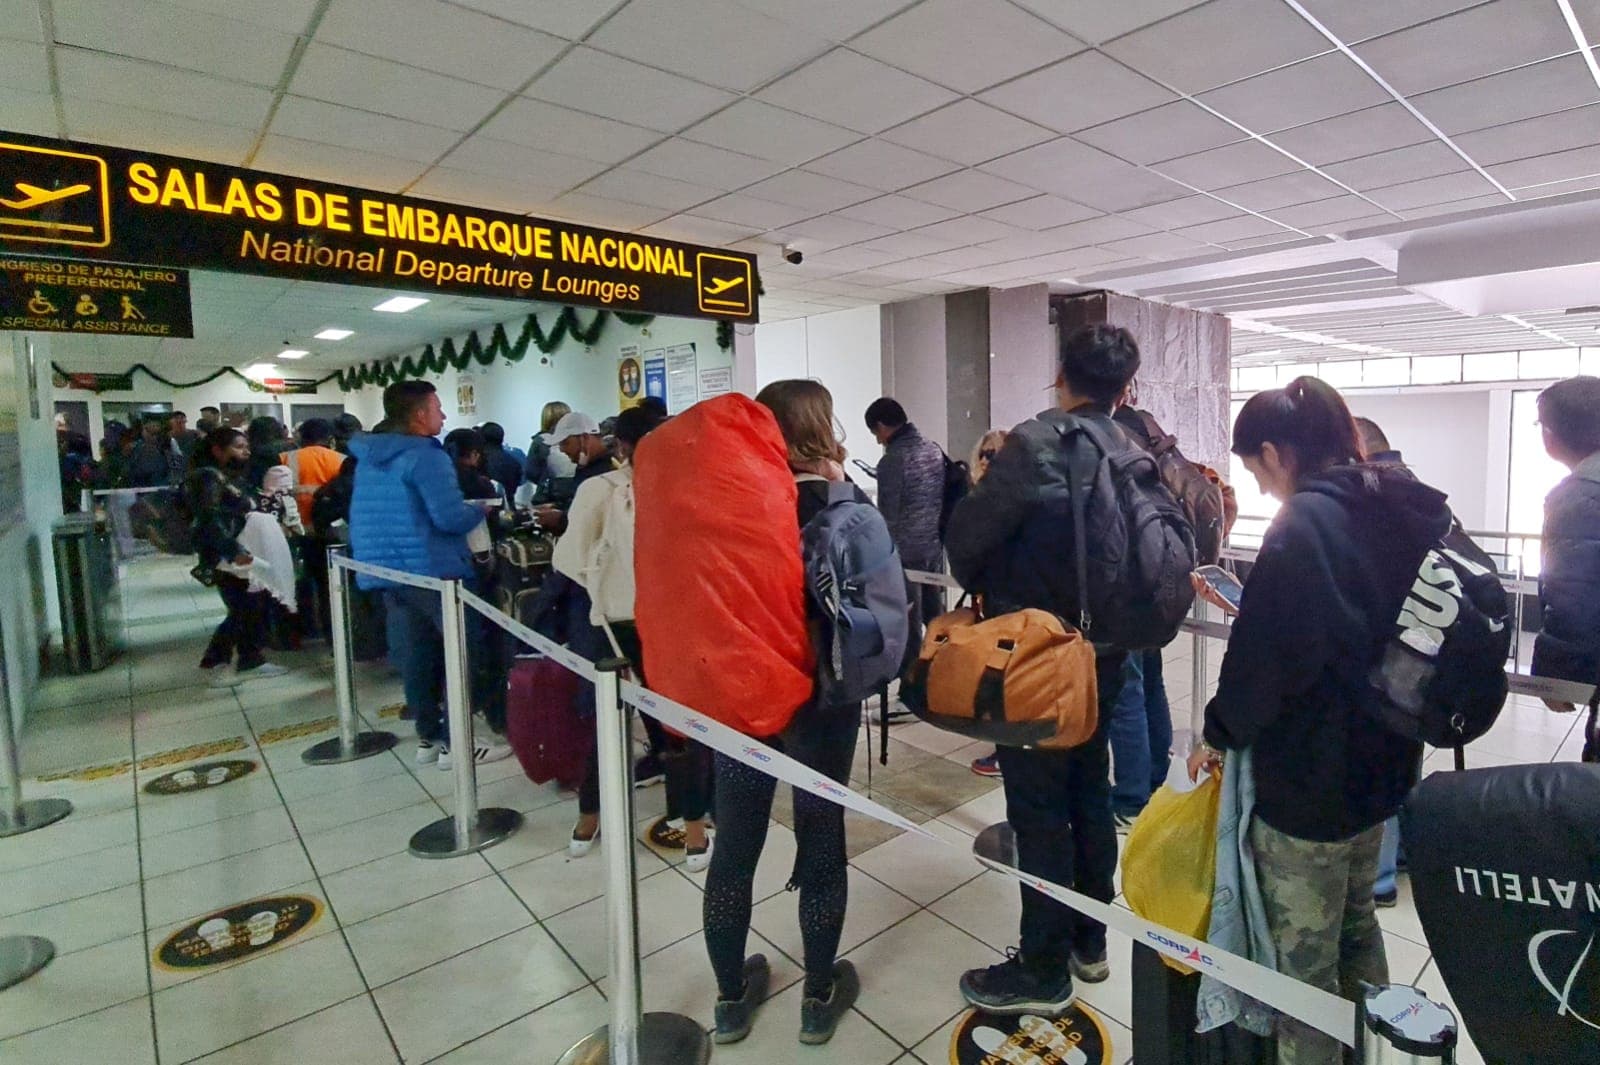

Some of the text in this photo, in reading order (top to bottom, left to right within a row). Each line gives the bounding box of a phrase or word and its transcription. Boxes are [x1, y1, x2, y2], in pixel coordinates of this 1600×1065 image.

[129, 162, 693, 278] SALAS DE EMBARQUE NACIONAL
[68, 264, 89, 275] DE
[94, 266, 177, 283] PASAJERO
[240, 229, 641, 304] National Departure Lounges
[24, 272, 146, 292] PREFERENCIAL
[2, 316, 170, 334] SPECIAL ASSISTANCE
